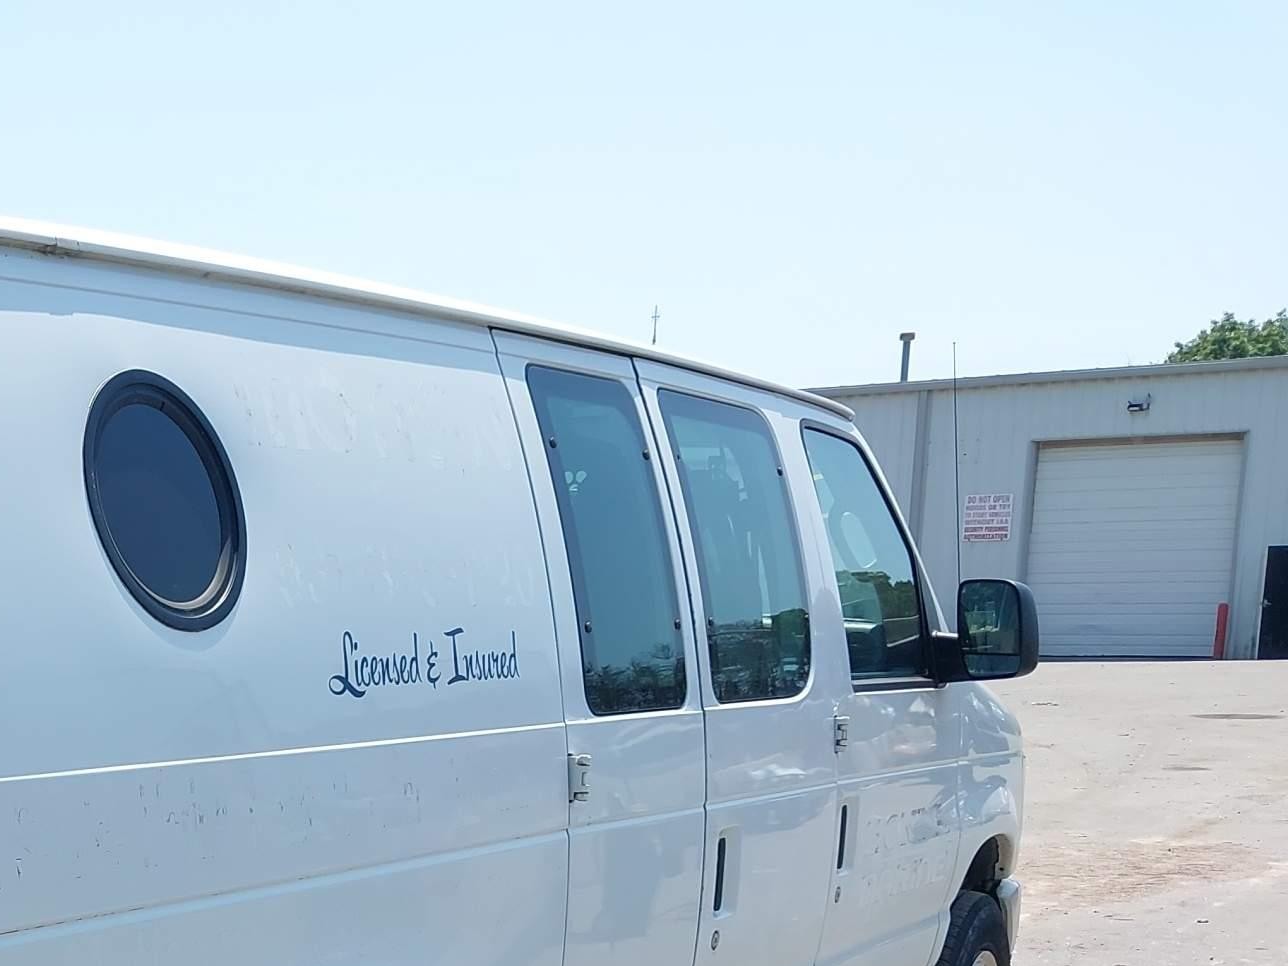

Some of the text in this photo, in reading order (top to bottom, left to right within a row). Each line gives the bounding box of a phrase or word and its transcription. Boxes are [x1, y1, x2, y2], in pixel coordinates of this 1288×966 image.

[968, 495, 1010, 504] DO NOT OPEN
[328, 627, 520, 699] Licensed & Insured
